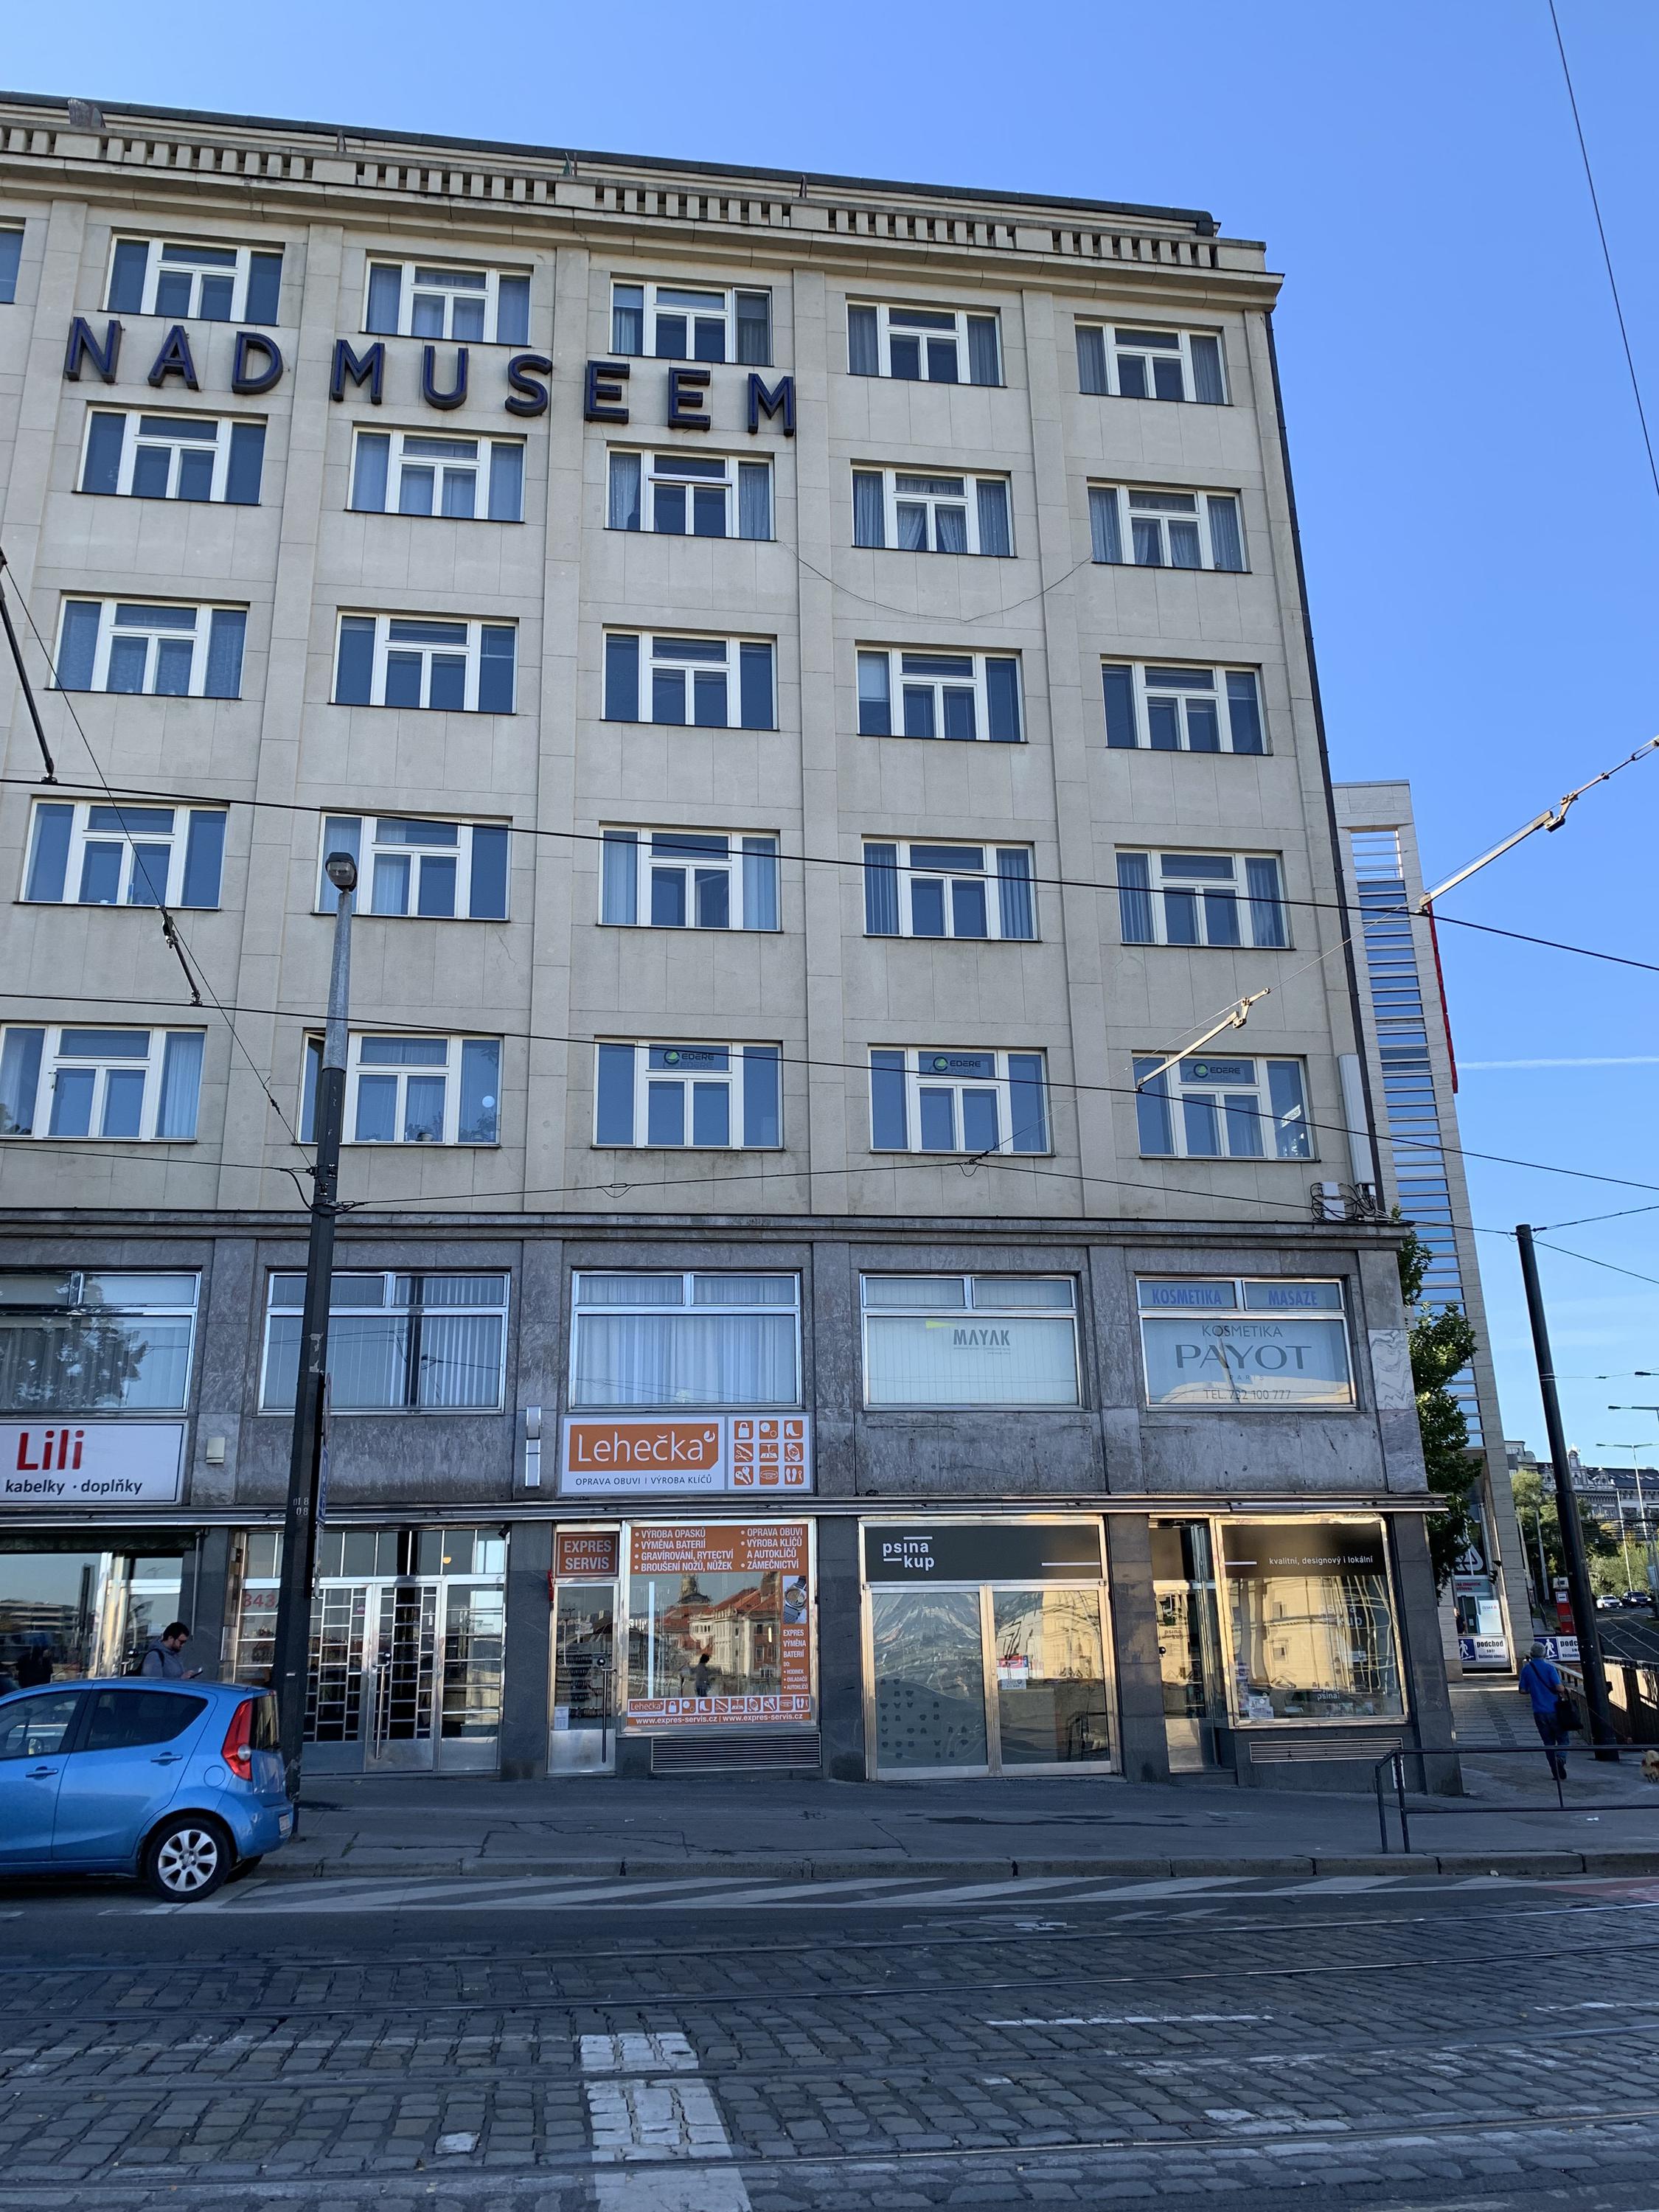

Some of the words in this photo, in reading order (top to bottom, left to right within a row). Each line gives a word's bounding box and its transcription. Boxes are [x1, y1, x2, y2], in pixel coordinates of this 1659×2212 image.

[64, 316, 285, 394] NAD
[330, 338, 796, 437] MUSEEM
[681, 1052, 714, 1061] EDERE
[949, 1060, 981, 1068] EDERE
[1209, 1066, 1241, 1074] EDERE
[1152, 1288, 1222, 1305] KOSMETIKA
[1202, 1324, 1283, 1338] KOSMETIKA
[953, 1329, 1010, 1346] MAYAK
[1175, 1343, 1312, 1370] PAYOT
[1203, 1389, 1227, 1399] TEL.
[1253, 1390, 1269, 1399] 100
[1273, 1389, 1291, 1399] 777
[16, 1428, 85, 1471] Lili
[578, 1430, 703, 1463] Lehečka
[575, 1478, 611, 1486] OPRAVA
[613, 1477, 641, 1485] OBUVI
[650, 1475, 686, 1484] VÝROBA
[687, 1474, 712, 1484] KLÍČŮ
[5, 1478, 65, 1496] kabelky
[80, 1478, 143, 1496] doplňky
[641, 1528, 673, 1539] VÝROBA
[675, 1527, 706, 1538] OPASKŮ
[747, 1528, 778, 1537] OPRAVA
[779, 1527, 803, 1536] OBUVI
[564, 1540, 611, 1554] EXPRES
[641, 1539, 674, 1549] VÝMĚNA
[676, 1538, 706, 1548] BATERIÍ
[747, 1537, 778, 1548] VÝROBA
[779, 1536, 802, 1547] KLÍČŮ
[641, 1550, 696, 1561] GRAVÍROVÁNÍ,
[698, 1548, 734, 1559] RYTECTVÍ
[747, 1551, 753, 1559] A
[754, 1547, 796, 1558] AUTOKLÍČŮ
[883, 1542, 929, 1557] psina
[565, 1557, 609, 1571] SERVIS
[641, 1561, 681, 1571] BROUŠENÍ
[682, 1559, 706, 1572] NOŽŮ,
[707, 1559, 732, 1571] NŮŽEK
[747, 1559, 799, 1570] ZÁMEČNICTVÍ
[904, 1554, 934, 1571] kup
[1269, 1557, 1300, 1565] kvalitní,
[1302, 1556, 1341, 1565] designový
[1348, 1555, 1373, 1563] lokální
[783, 1638, 807, 1647] VÝMĚNA
[1560, 1639, 1578, 1647] podc
[783, 1649, 804, 1658] BATERIÍ
[630, 1702, 661, 1711] Lehečka
[636, 1716, 717, 1725] www.expres-servis.cz
[723, 1713, 804, 1722] www.expres-servis.cz
